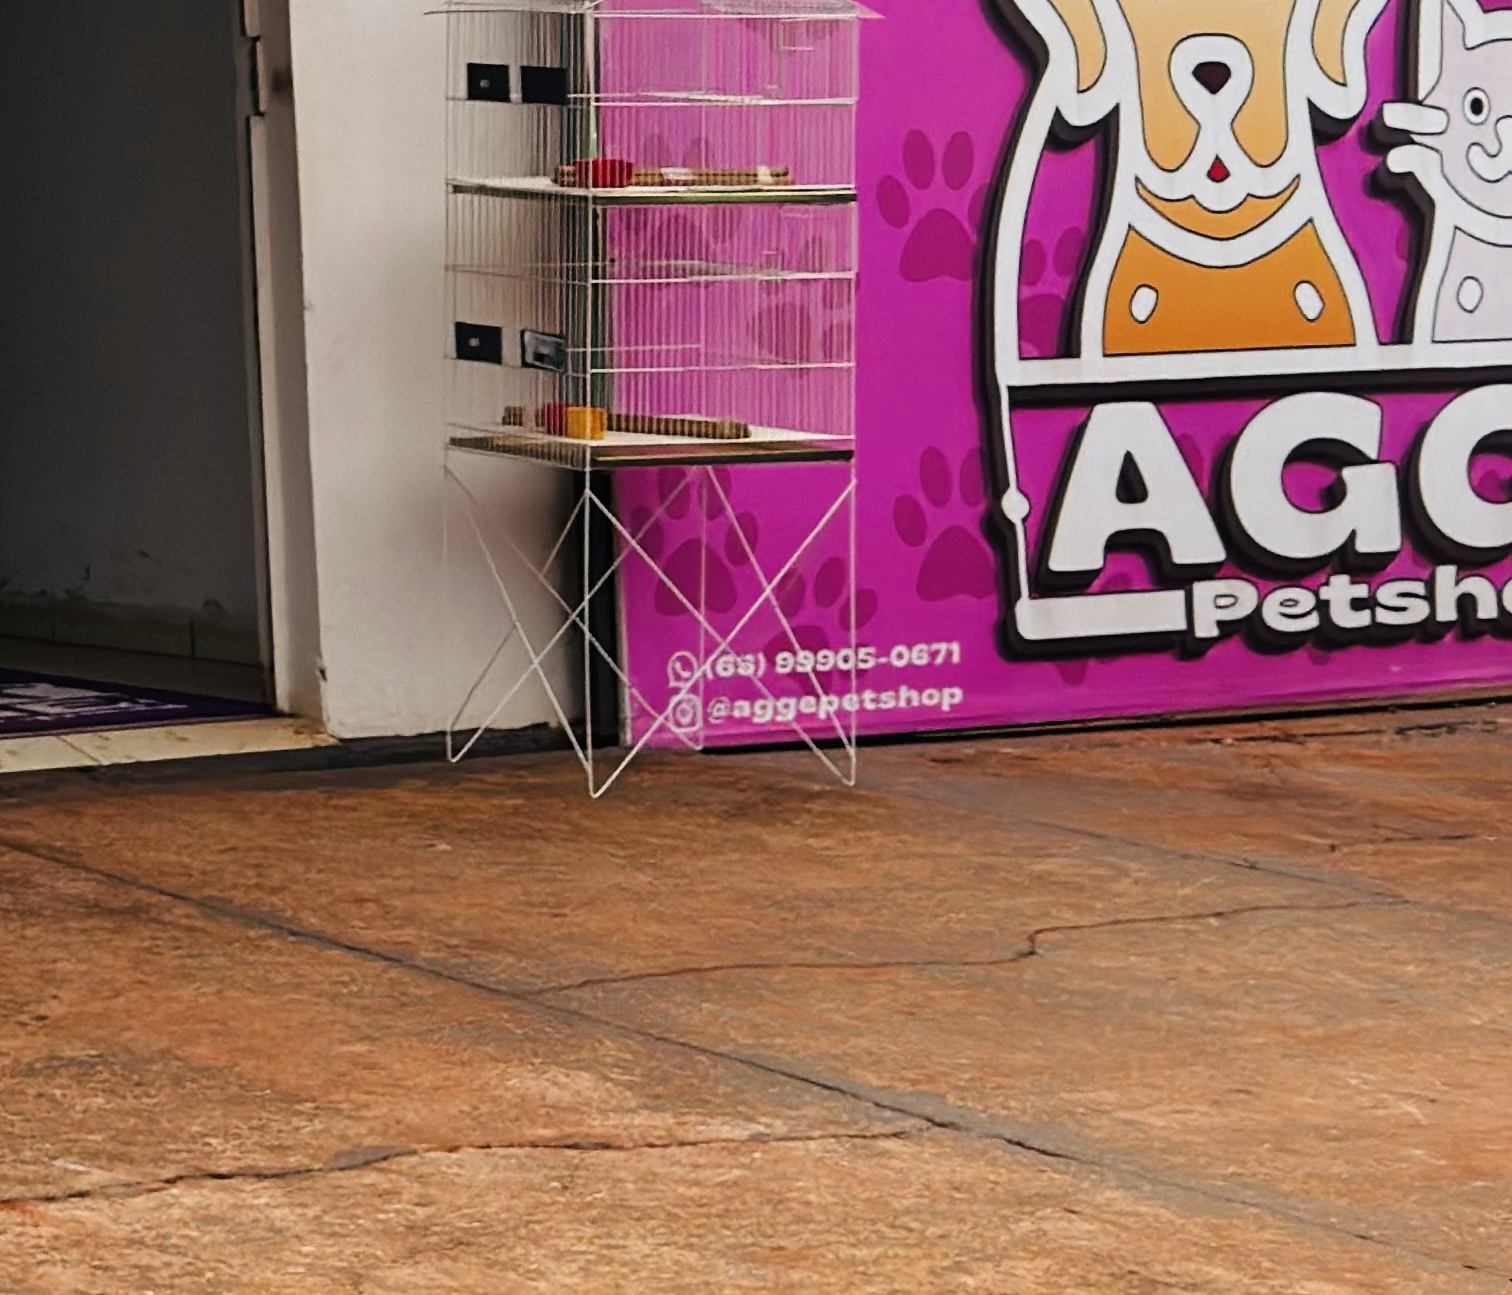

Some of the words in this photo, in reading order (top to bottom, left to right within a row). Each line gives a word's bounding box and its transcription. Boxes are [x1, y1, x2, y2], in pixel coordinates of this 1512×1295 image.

[1192, 564, 1512, 638] Petsh
[706, 652, 766, 680] (66)
[776, 640, 961, 673] 99905-0671
[707, 684, 963, 723] @aggepetshop
